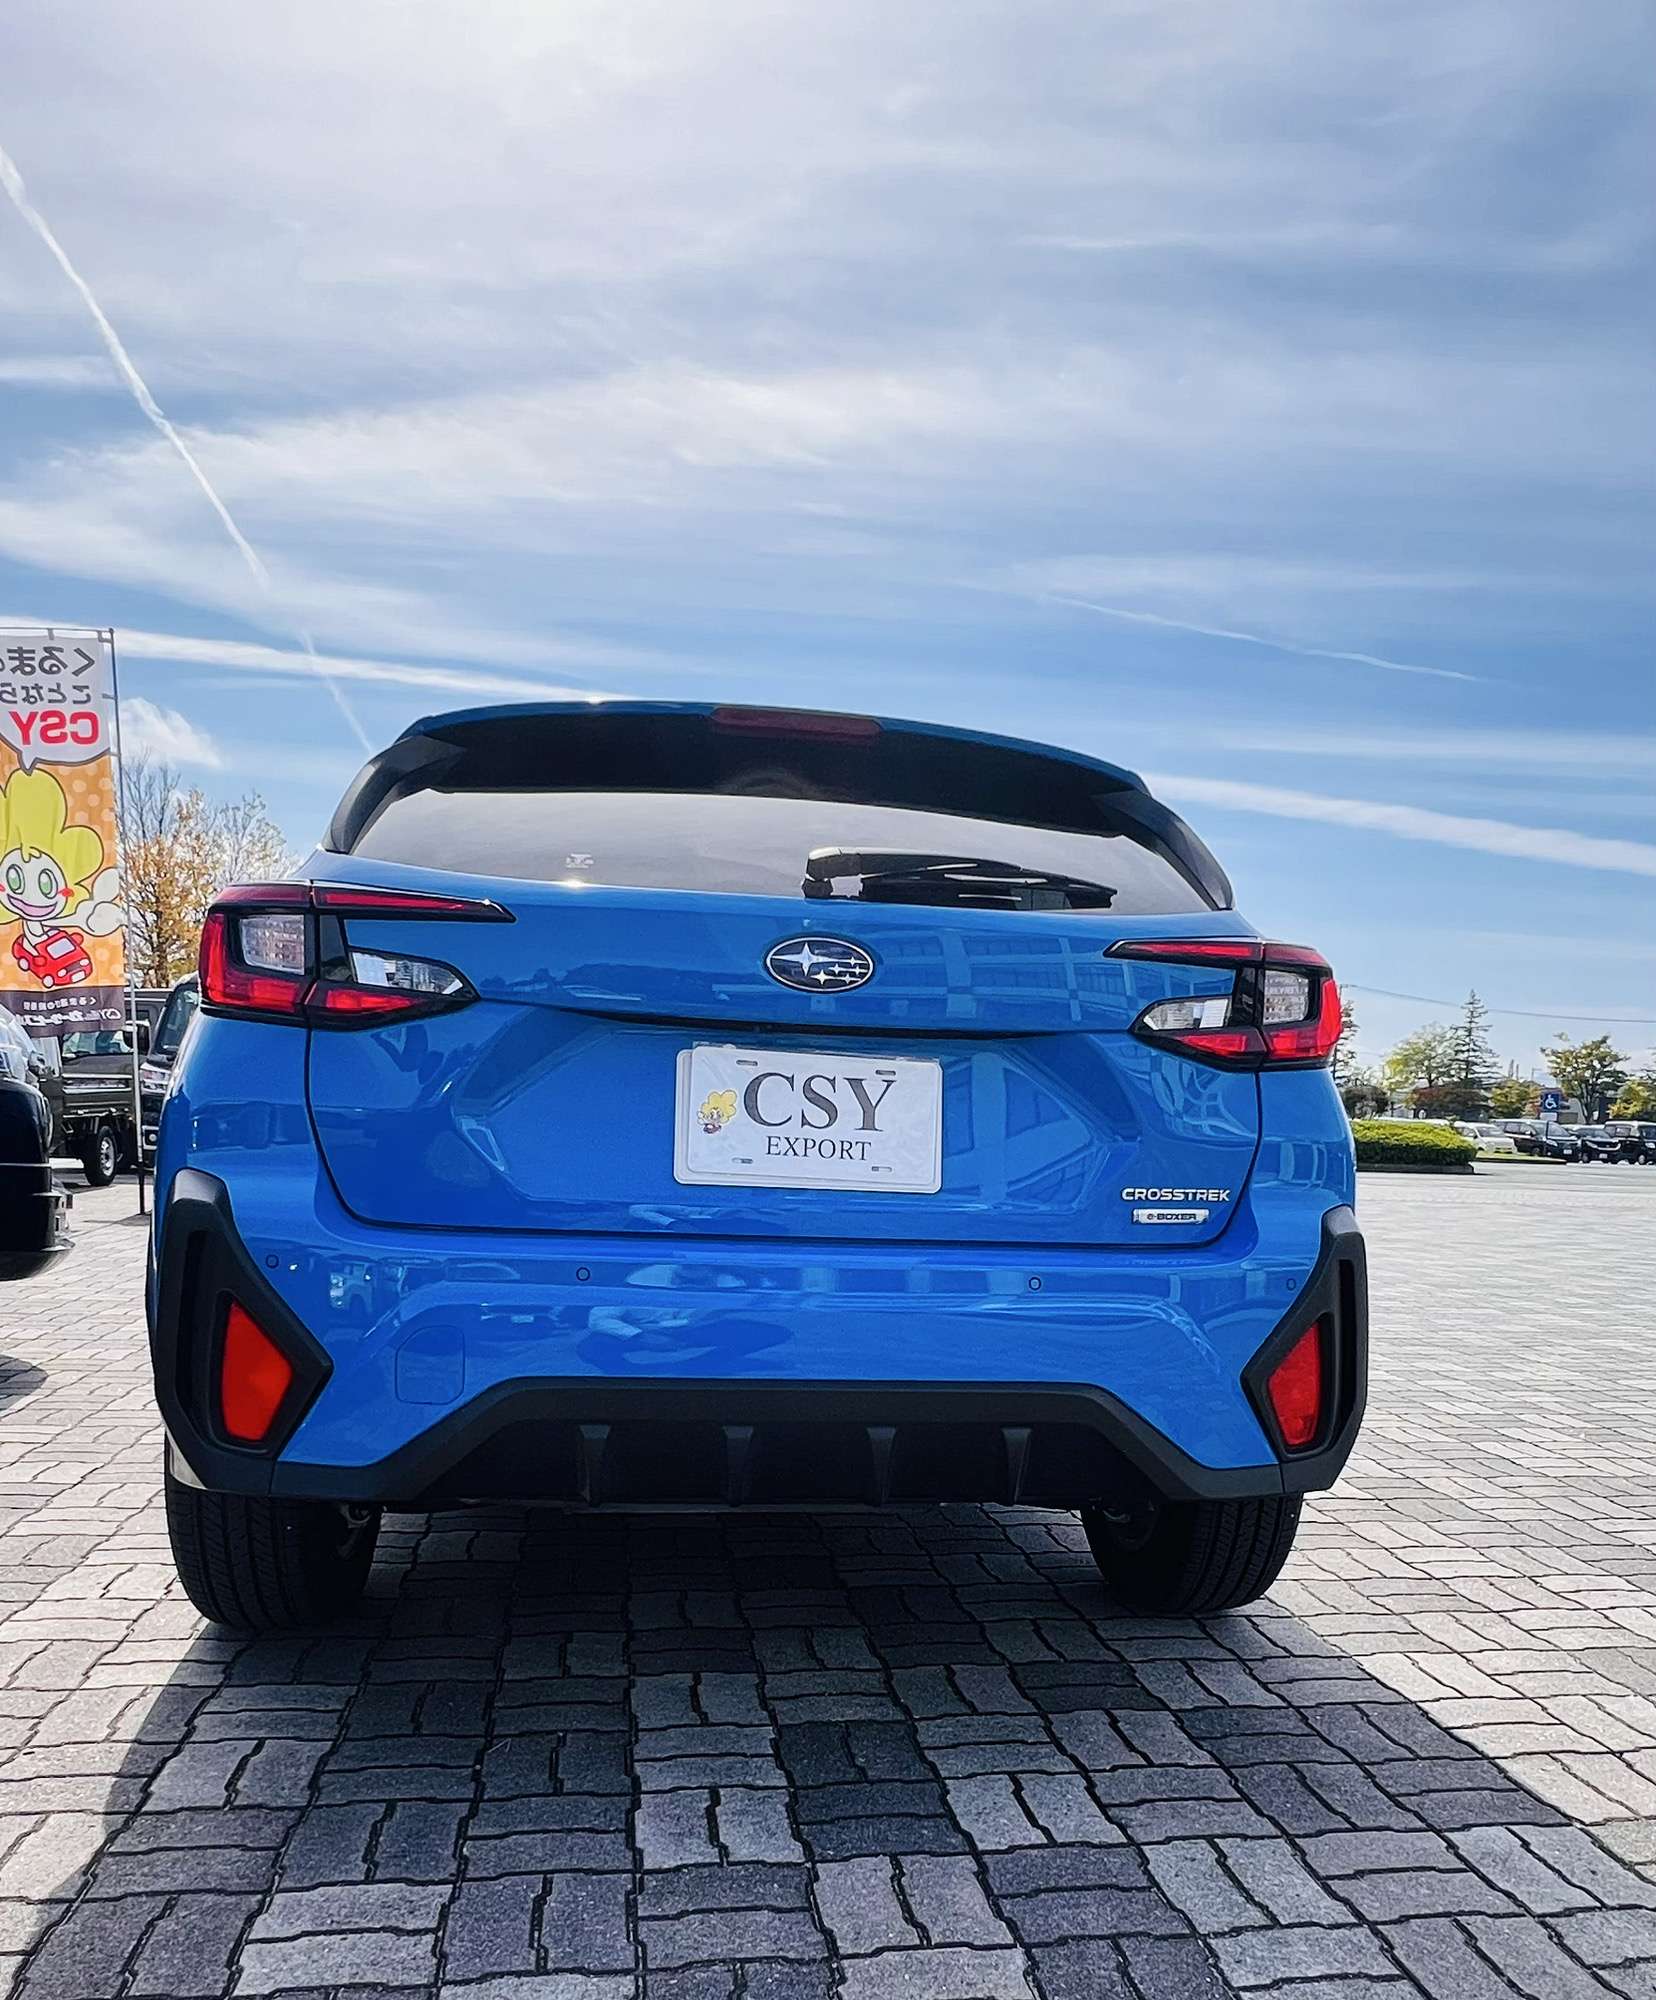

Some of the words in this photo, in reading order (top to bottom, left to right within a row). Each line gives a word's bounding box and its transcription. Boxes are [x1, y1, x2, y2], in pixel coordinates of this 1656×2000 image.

[743, 1072, 897, 1132] CSY
[766, 1136, 872, 1161] EXPORT
[1122, 1188, 1230, 1201] CROSSTREK
